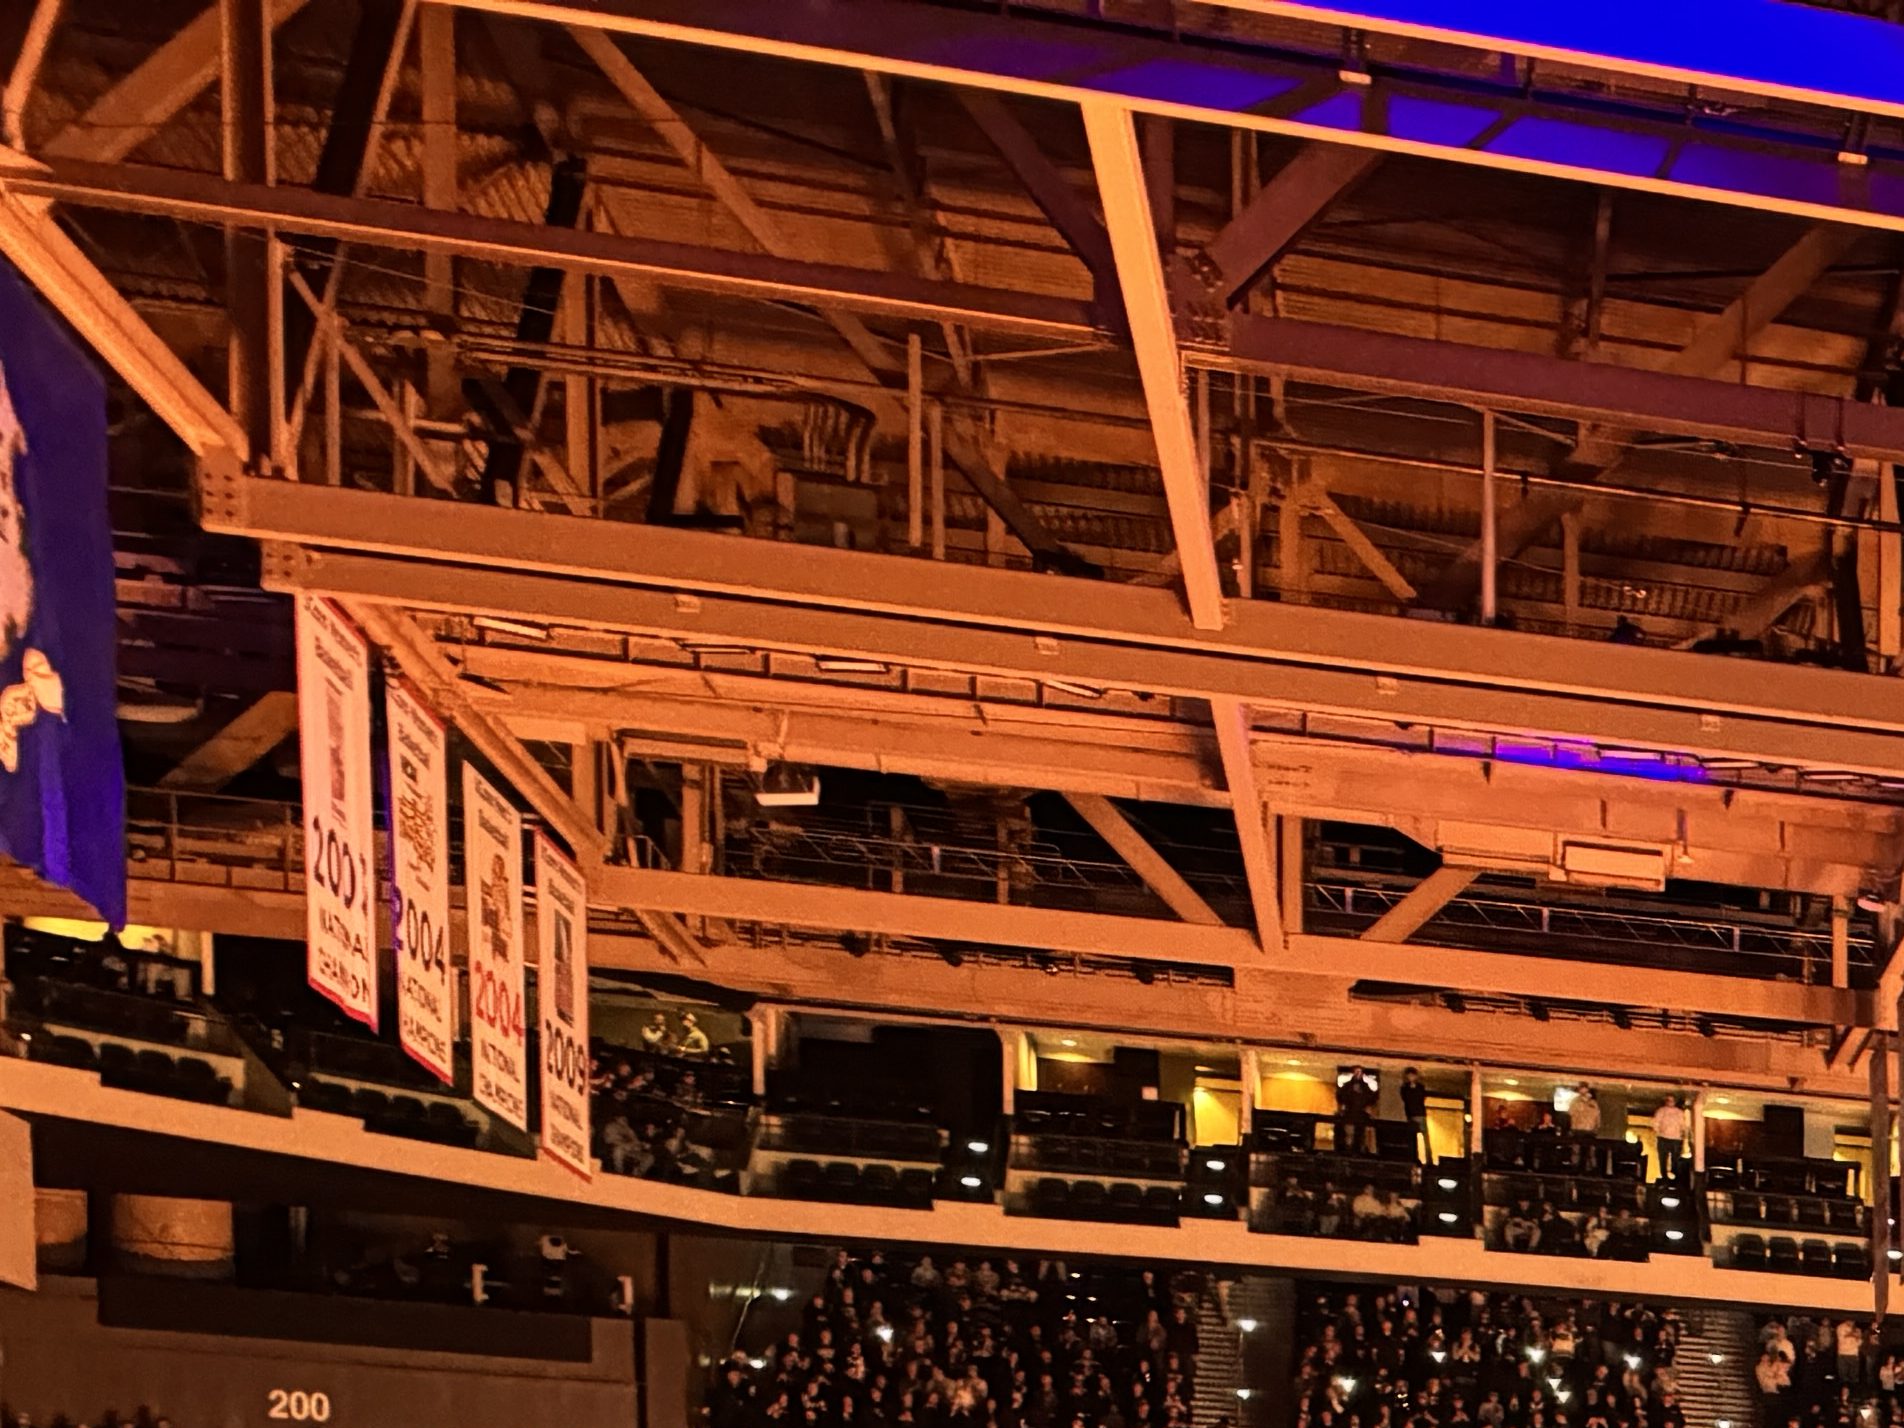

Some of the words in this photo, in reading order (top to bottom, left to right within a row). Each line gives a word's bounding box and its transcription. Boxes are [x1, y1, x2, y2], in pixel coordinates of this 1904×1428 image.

[393, 885, 446, 986] 2004
[475, 960, 523, 1046] 2004
[545, 1019, 586, 1096] 2009
[268, 1389, 330, 1422] 200
